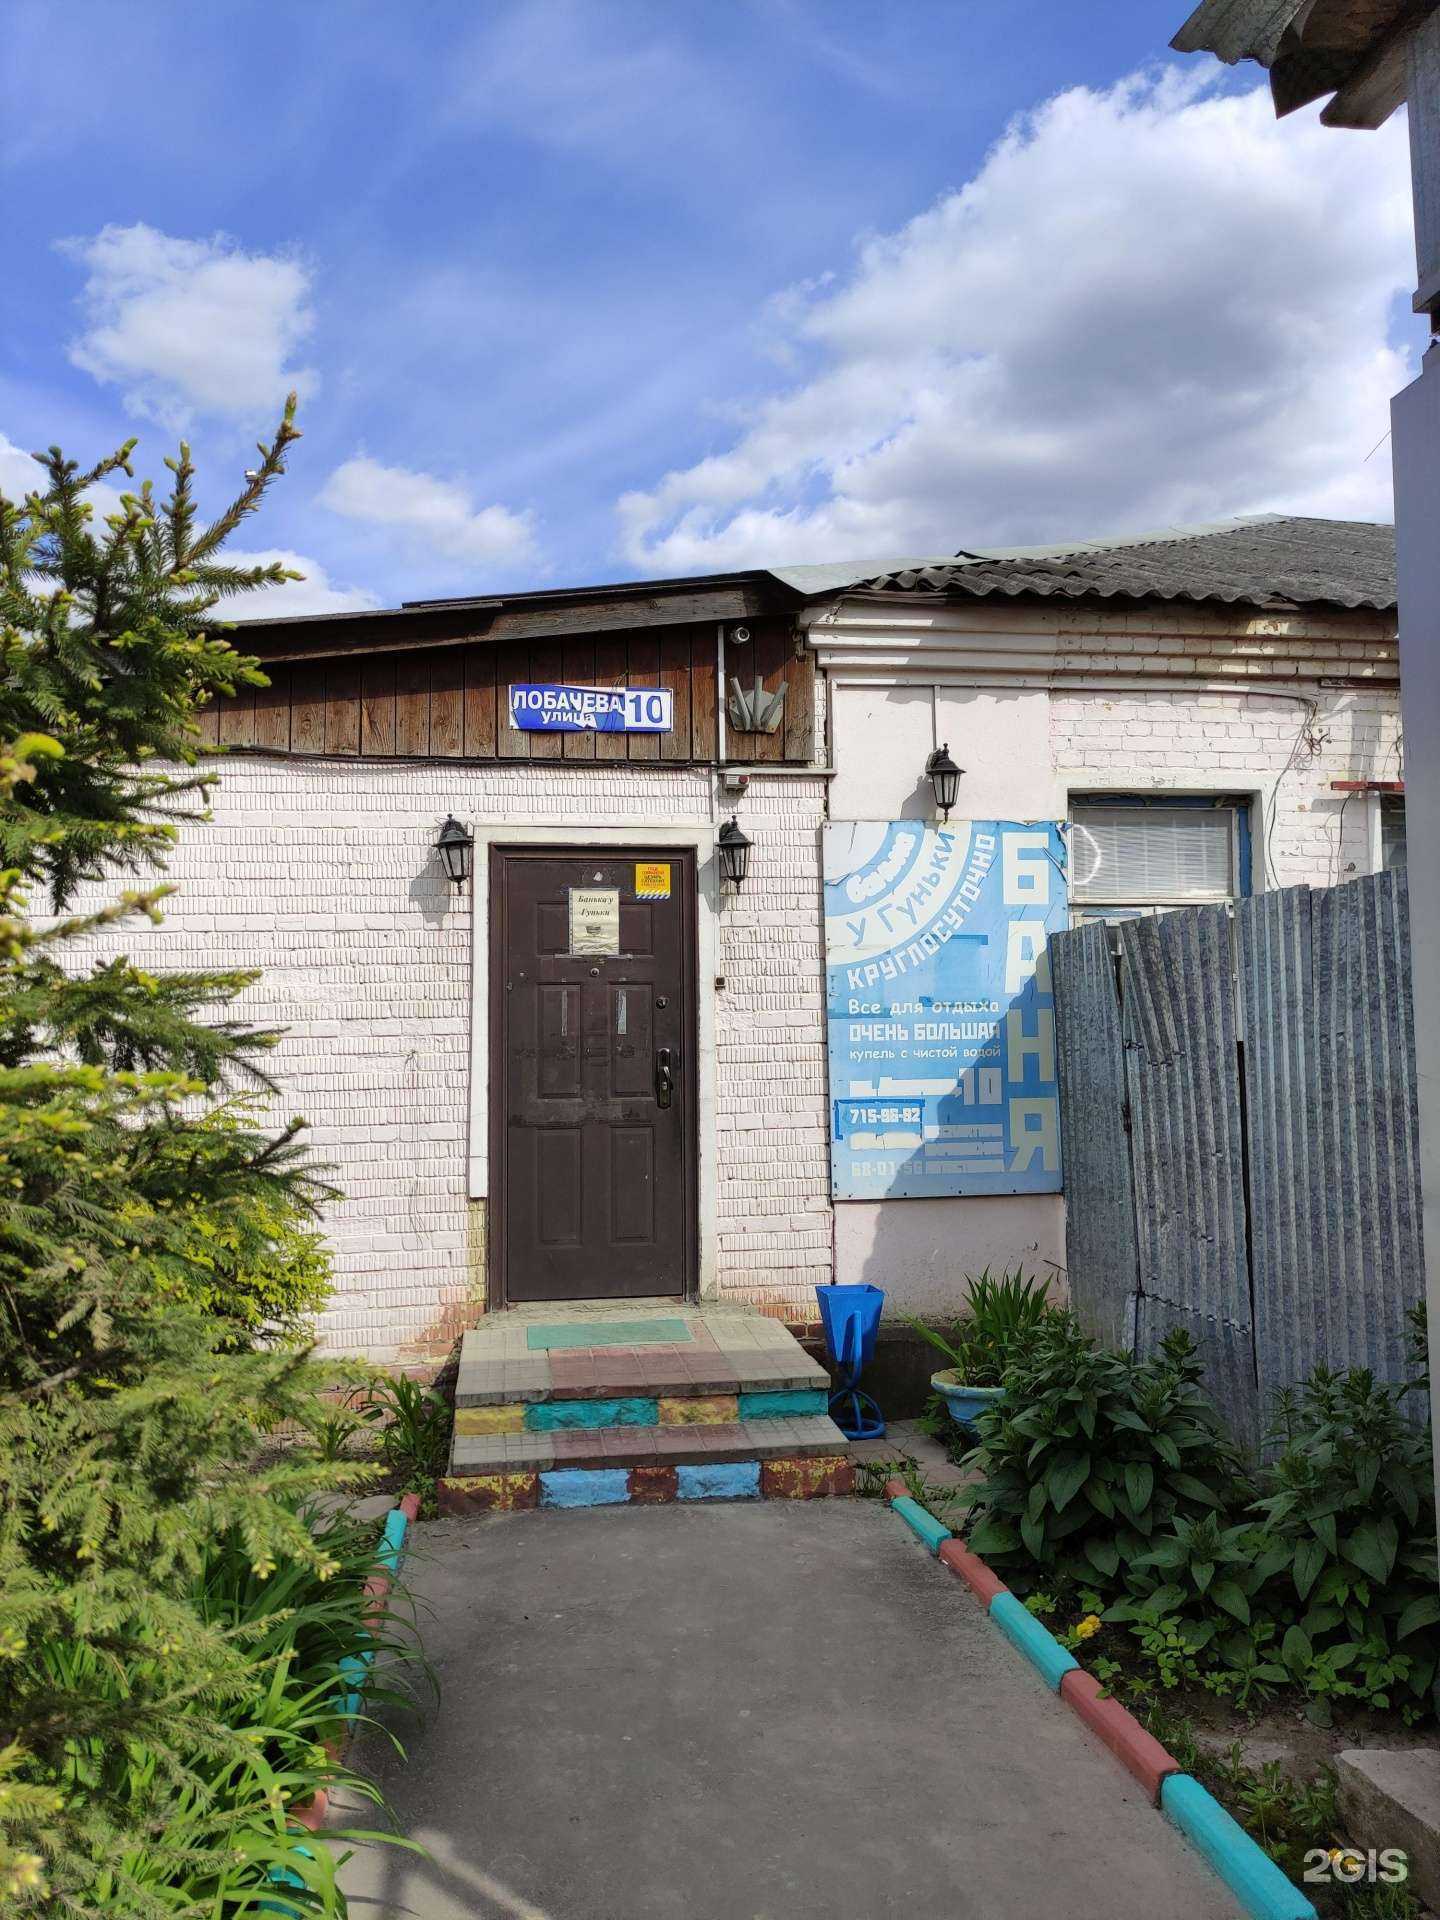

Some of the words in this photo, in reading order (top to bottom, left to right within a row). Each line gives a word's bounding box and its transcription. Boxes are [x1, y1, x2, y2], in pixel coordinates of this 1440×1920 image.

[513, 690, 624, 713] ЛОБАЧЕВА
[629, 694, 663, 723] 10
[541, 710, 596, 725] улица
[846, 833, 996, 990] КРУГЛОСУТОЧНО
[846, 917, 866, 946] У
[848, 998, 881, 1014] Все
[890, 1001, 924, 1016] для
[932, 1000, 1000, 1015] отдыха
[1002, 832, 1058, 1172] БАНЯ
[849, 1023, 909, 1041] ОЧЕНЬ
[913, 1022, 1000, 1041] БОЛЬШАЯ
[850, 1049, 896, 1063] купель
[900, 1049, 908, 1058] с
[913, 1046, 958, 1058] чистой
[963, 1045, 1001, 1058] водой
